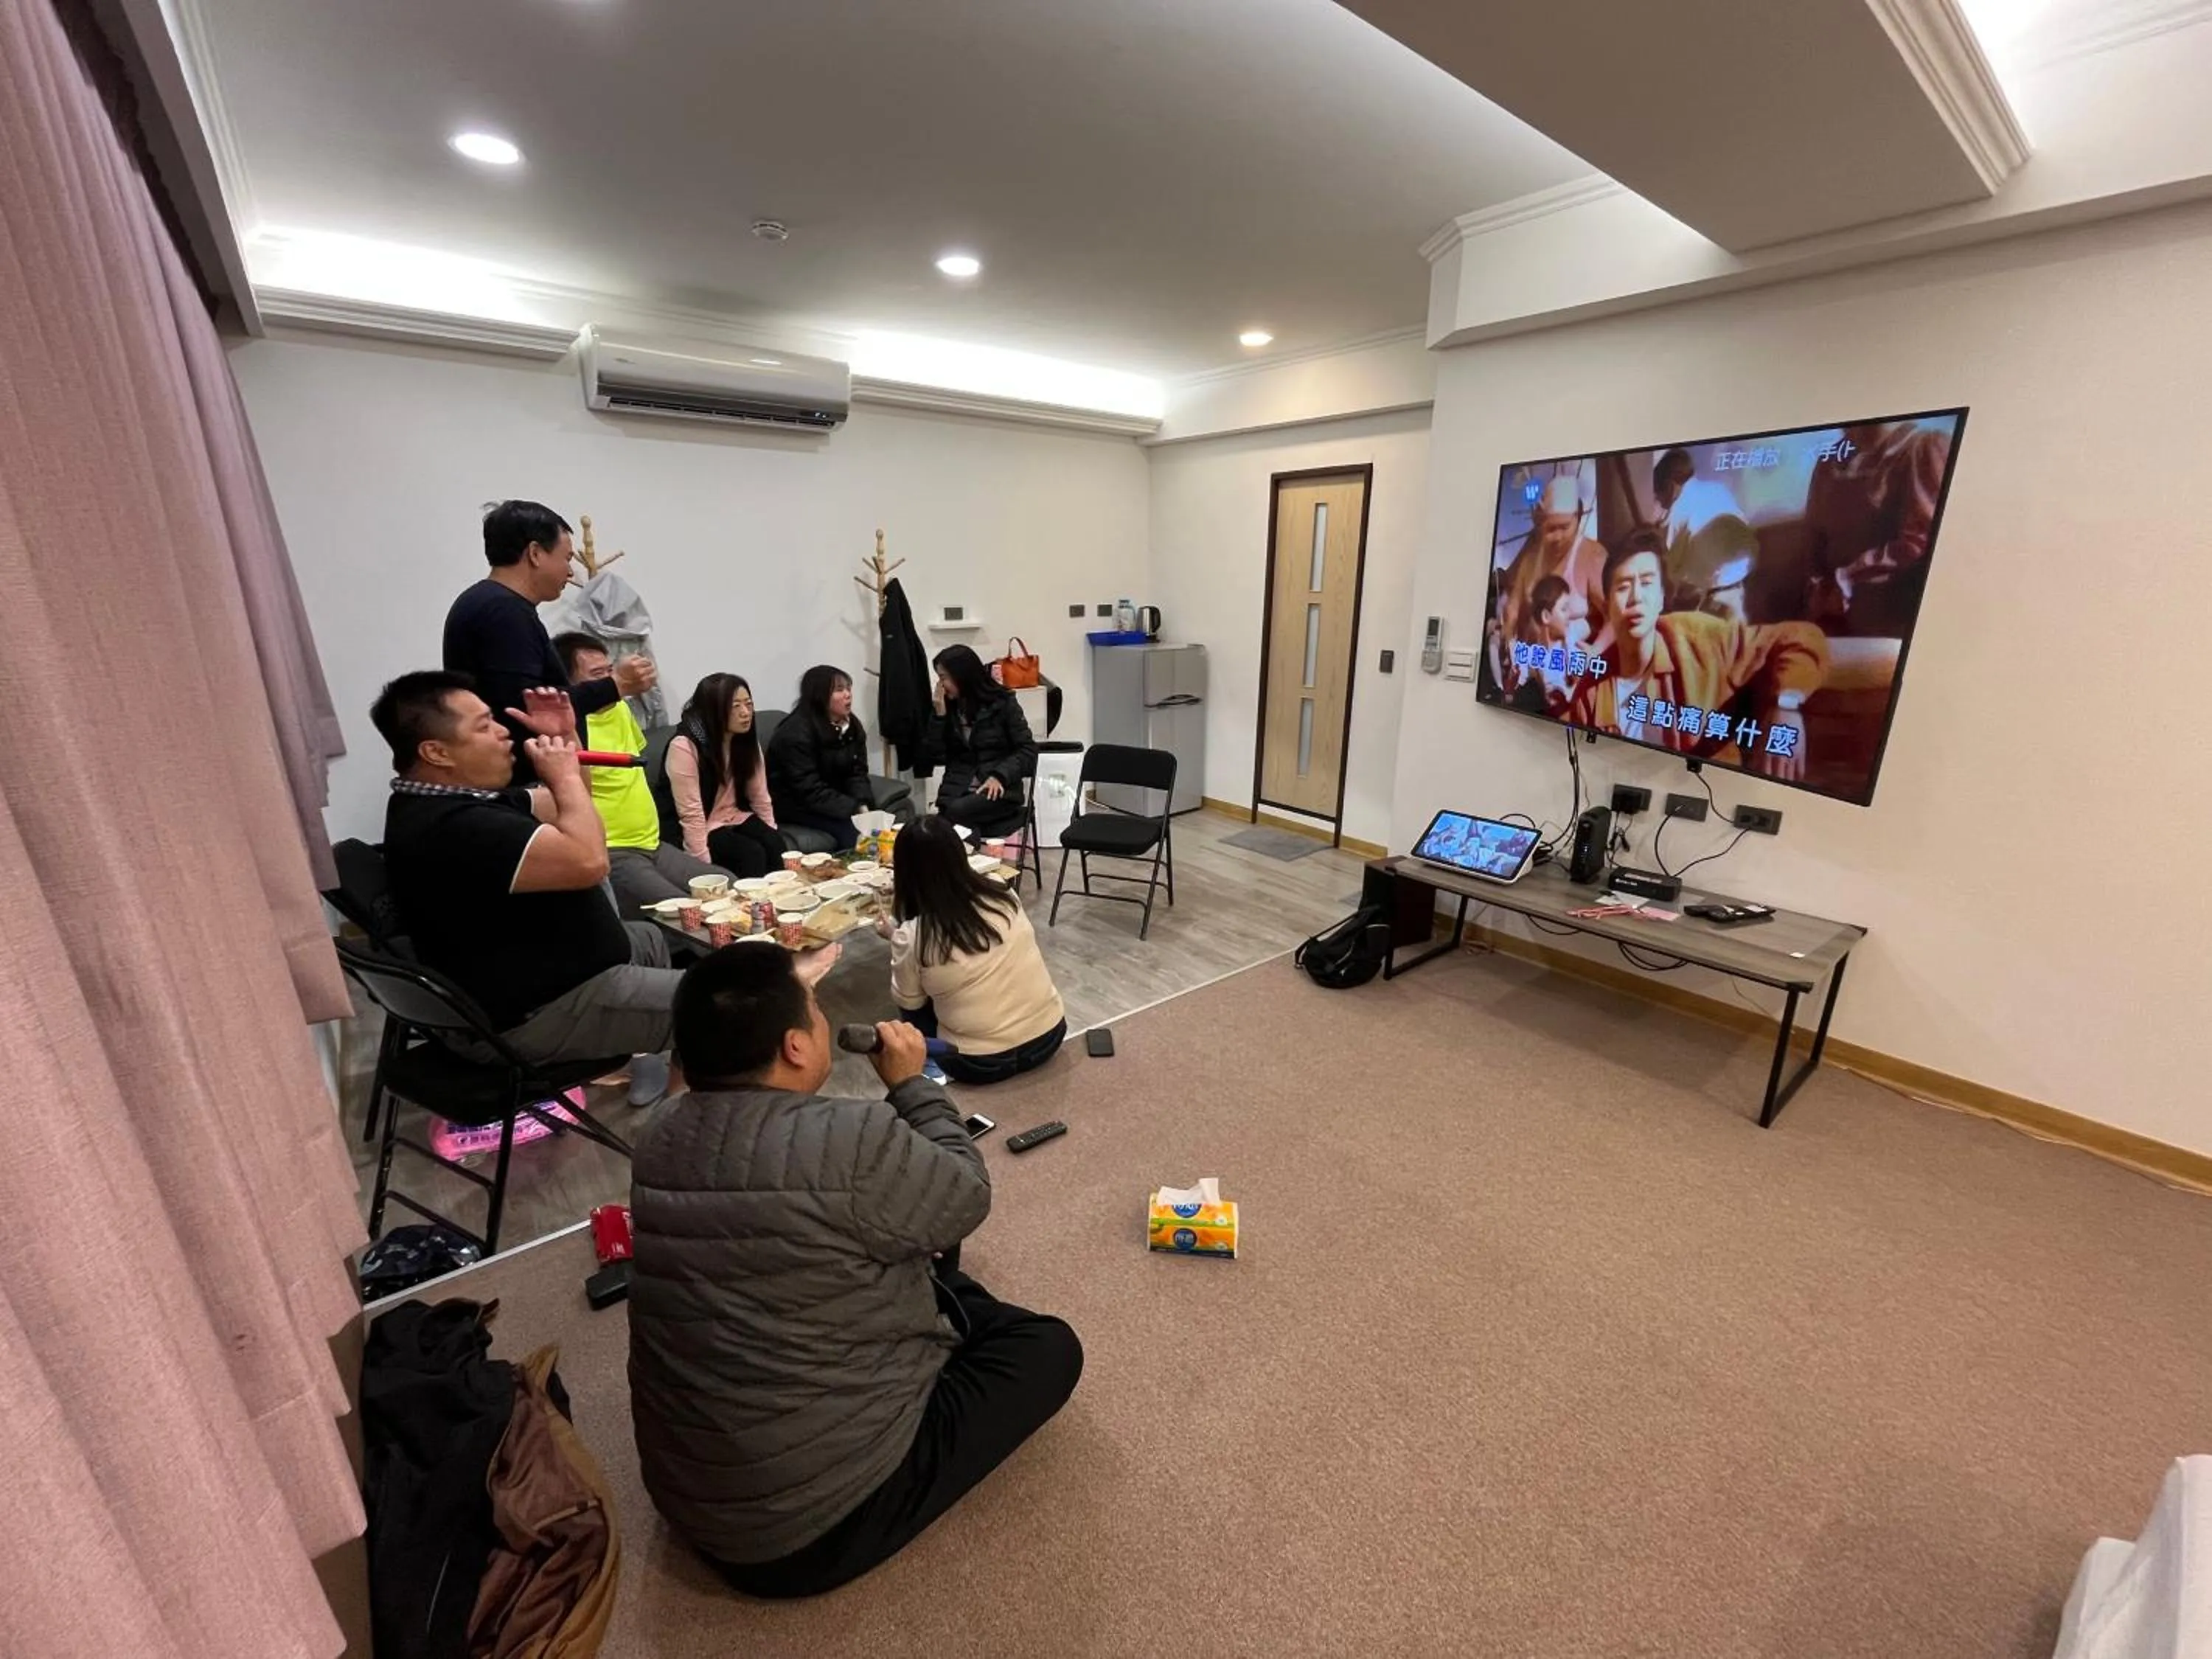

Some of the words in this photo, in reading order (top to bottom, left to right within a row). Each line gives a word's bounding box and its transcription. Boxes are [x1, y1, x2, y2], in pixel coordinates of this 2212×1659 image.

[1515, 641, 1607, 680] 他說風雨中
[1627, 695, 1798, 757] 這點痛算什麼
